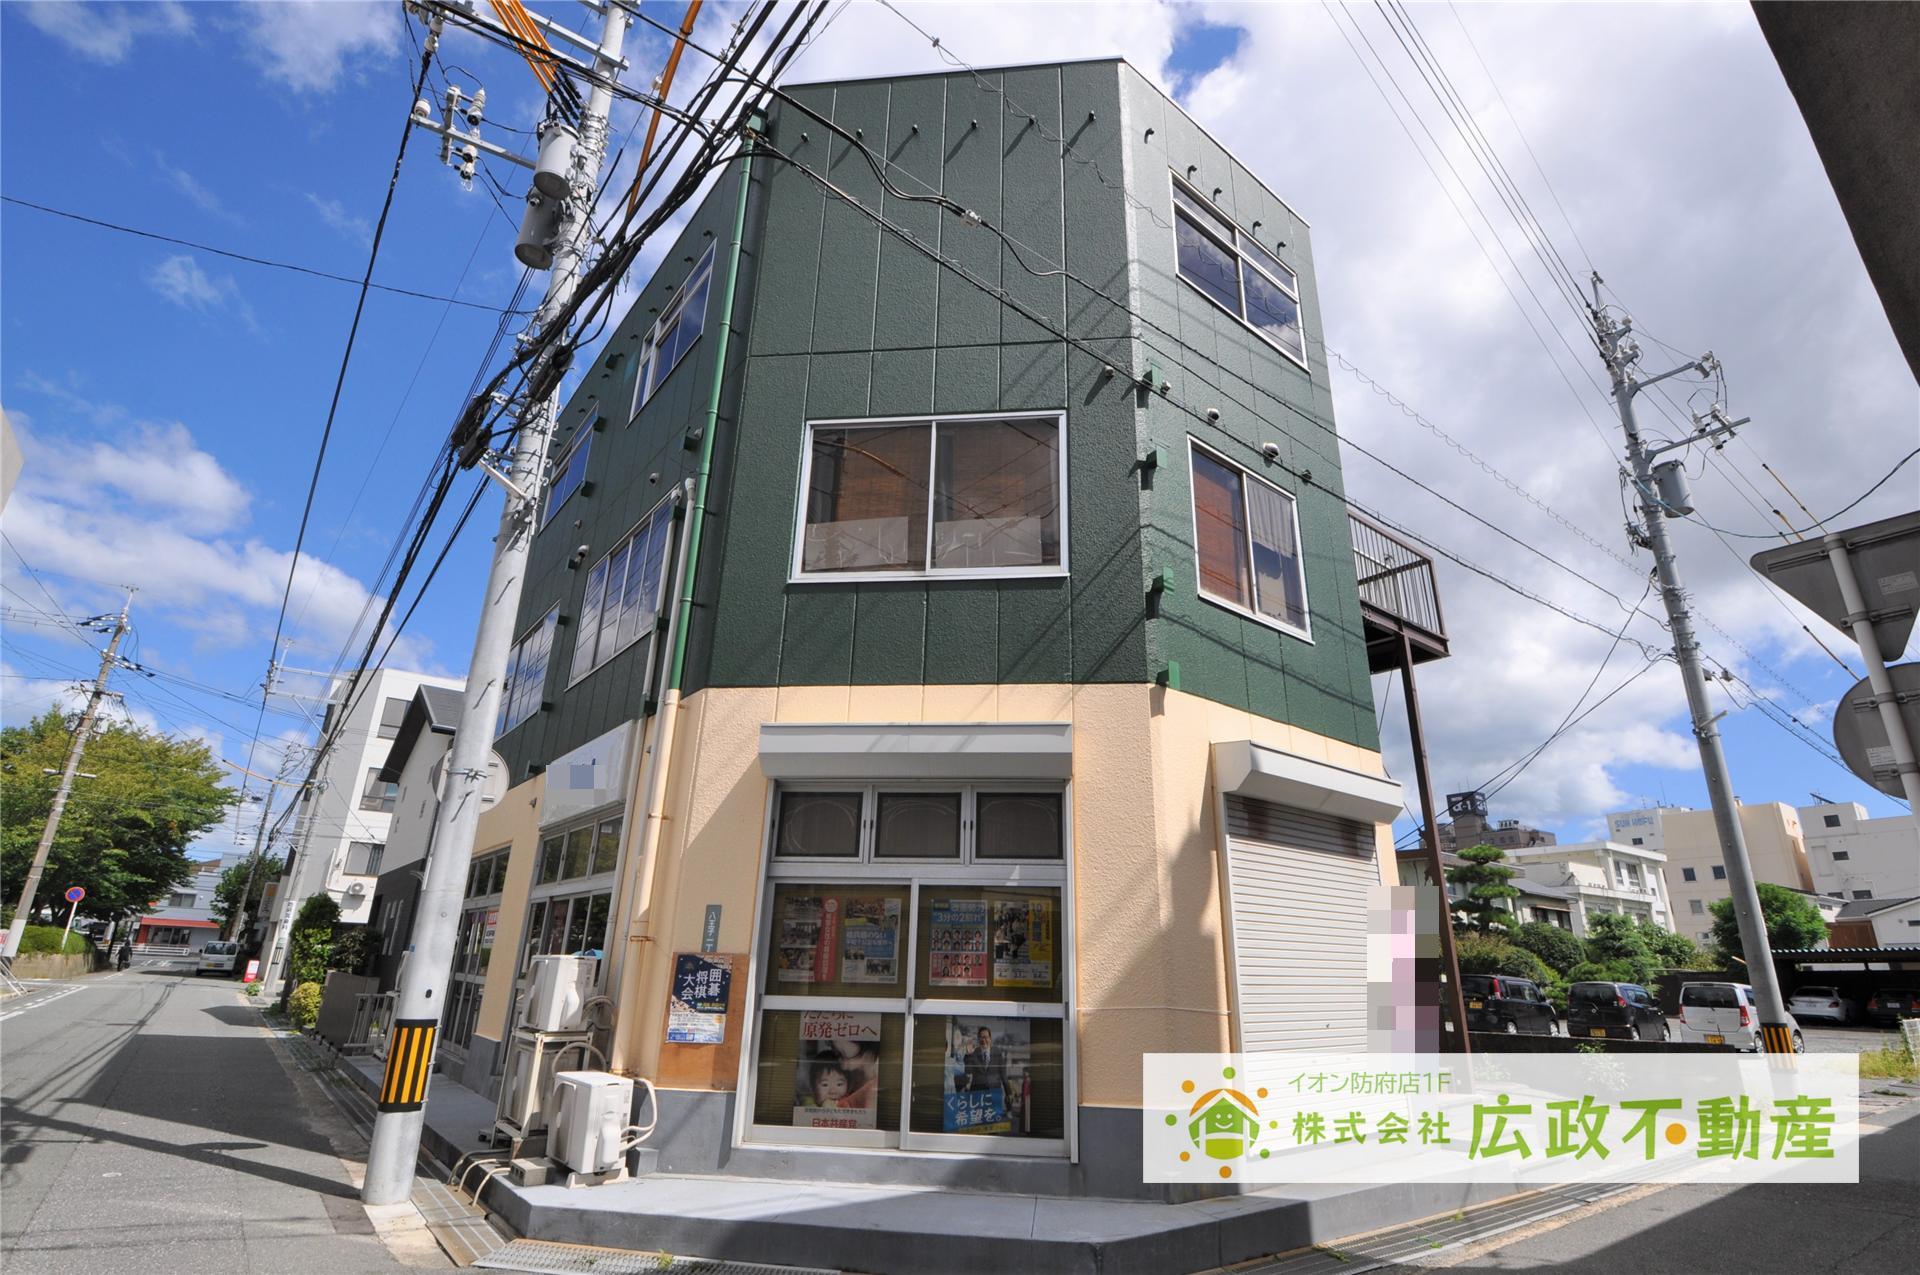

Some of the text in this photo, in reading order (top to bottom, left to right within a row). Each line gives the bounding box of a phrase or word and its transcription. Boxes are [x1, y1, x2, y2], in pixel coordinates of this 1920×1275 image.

[681, 973, 695, 1000] 大会
[694, 970, 708, 998] 将棋
[707, 968, 722, 996] 囲碁
[803, 1022, 877, 1039] 原発ゼロへ
[946, 1093, 993, 1111] くらしに
[955, 1108, 1002, 1126] 希望を。
